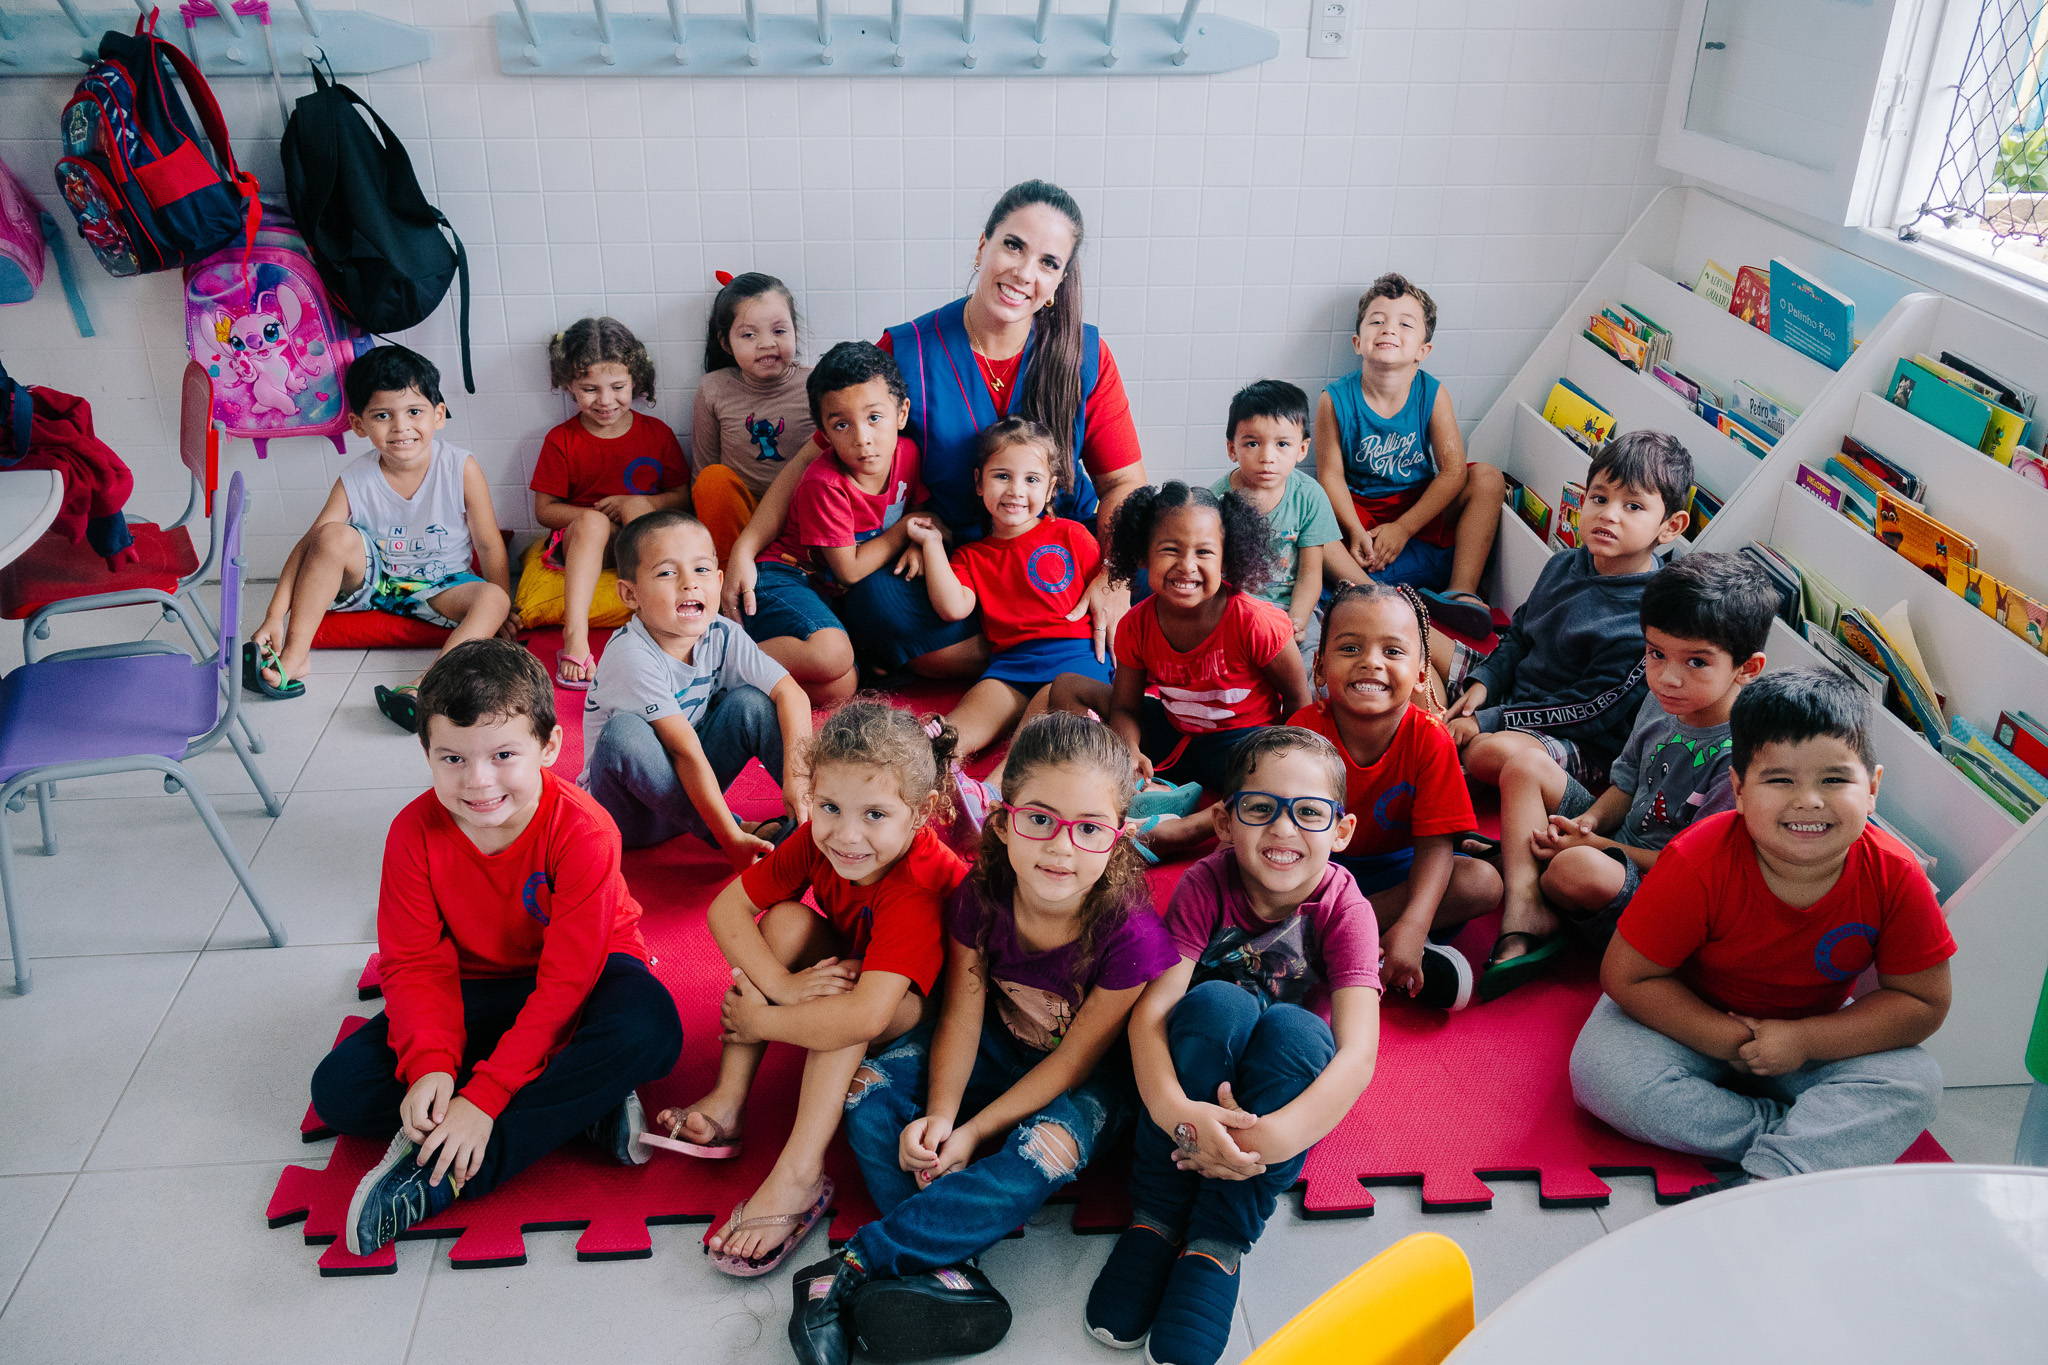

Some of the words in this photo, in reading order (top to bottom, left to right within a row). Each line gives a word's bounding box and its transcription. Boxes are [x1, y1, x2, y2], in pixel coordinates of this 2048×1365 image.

[1779, 298, 1787, 310] O
[1787, 302, 1818, 330] Patinho
[1818, 321, 1837, 342] Feio
[1749, 398, 1769, 419] Pedro
[1356, 431, 1417, 469] Rolling
[1050, 578, 1070, 592] PAULO
[1597, 692, 1618, 708] GB
[1546, 705, 1598, 723] DENIM
